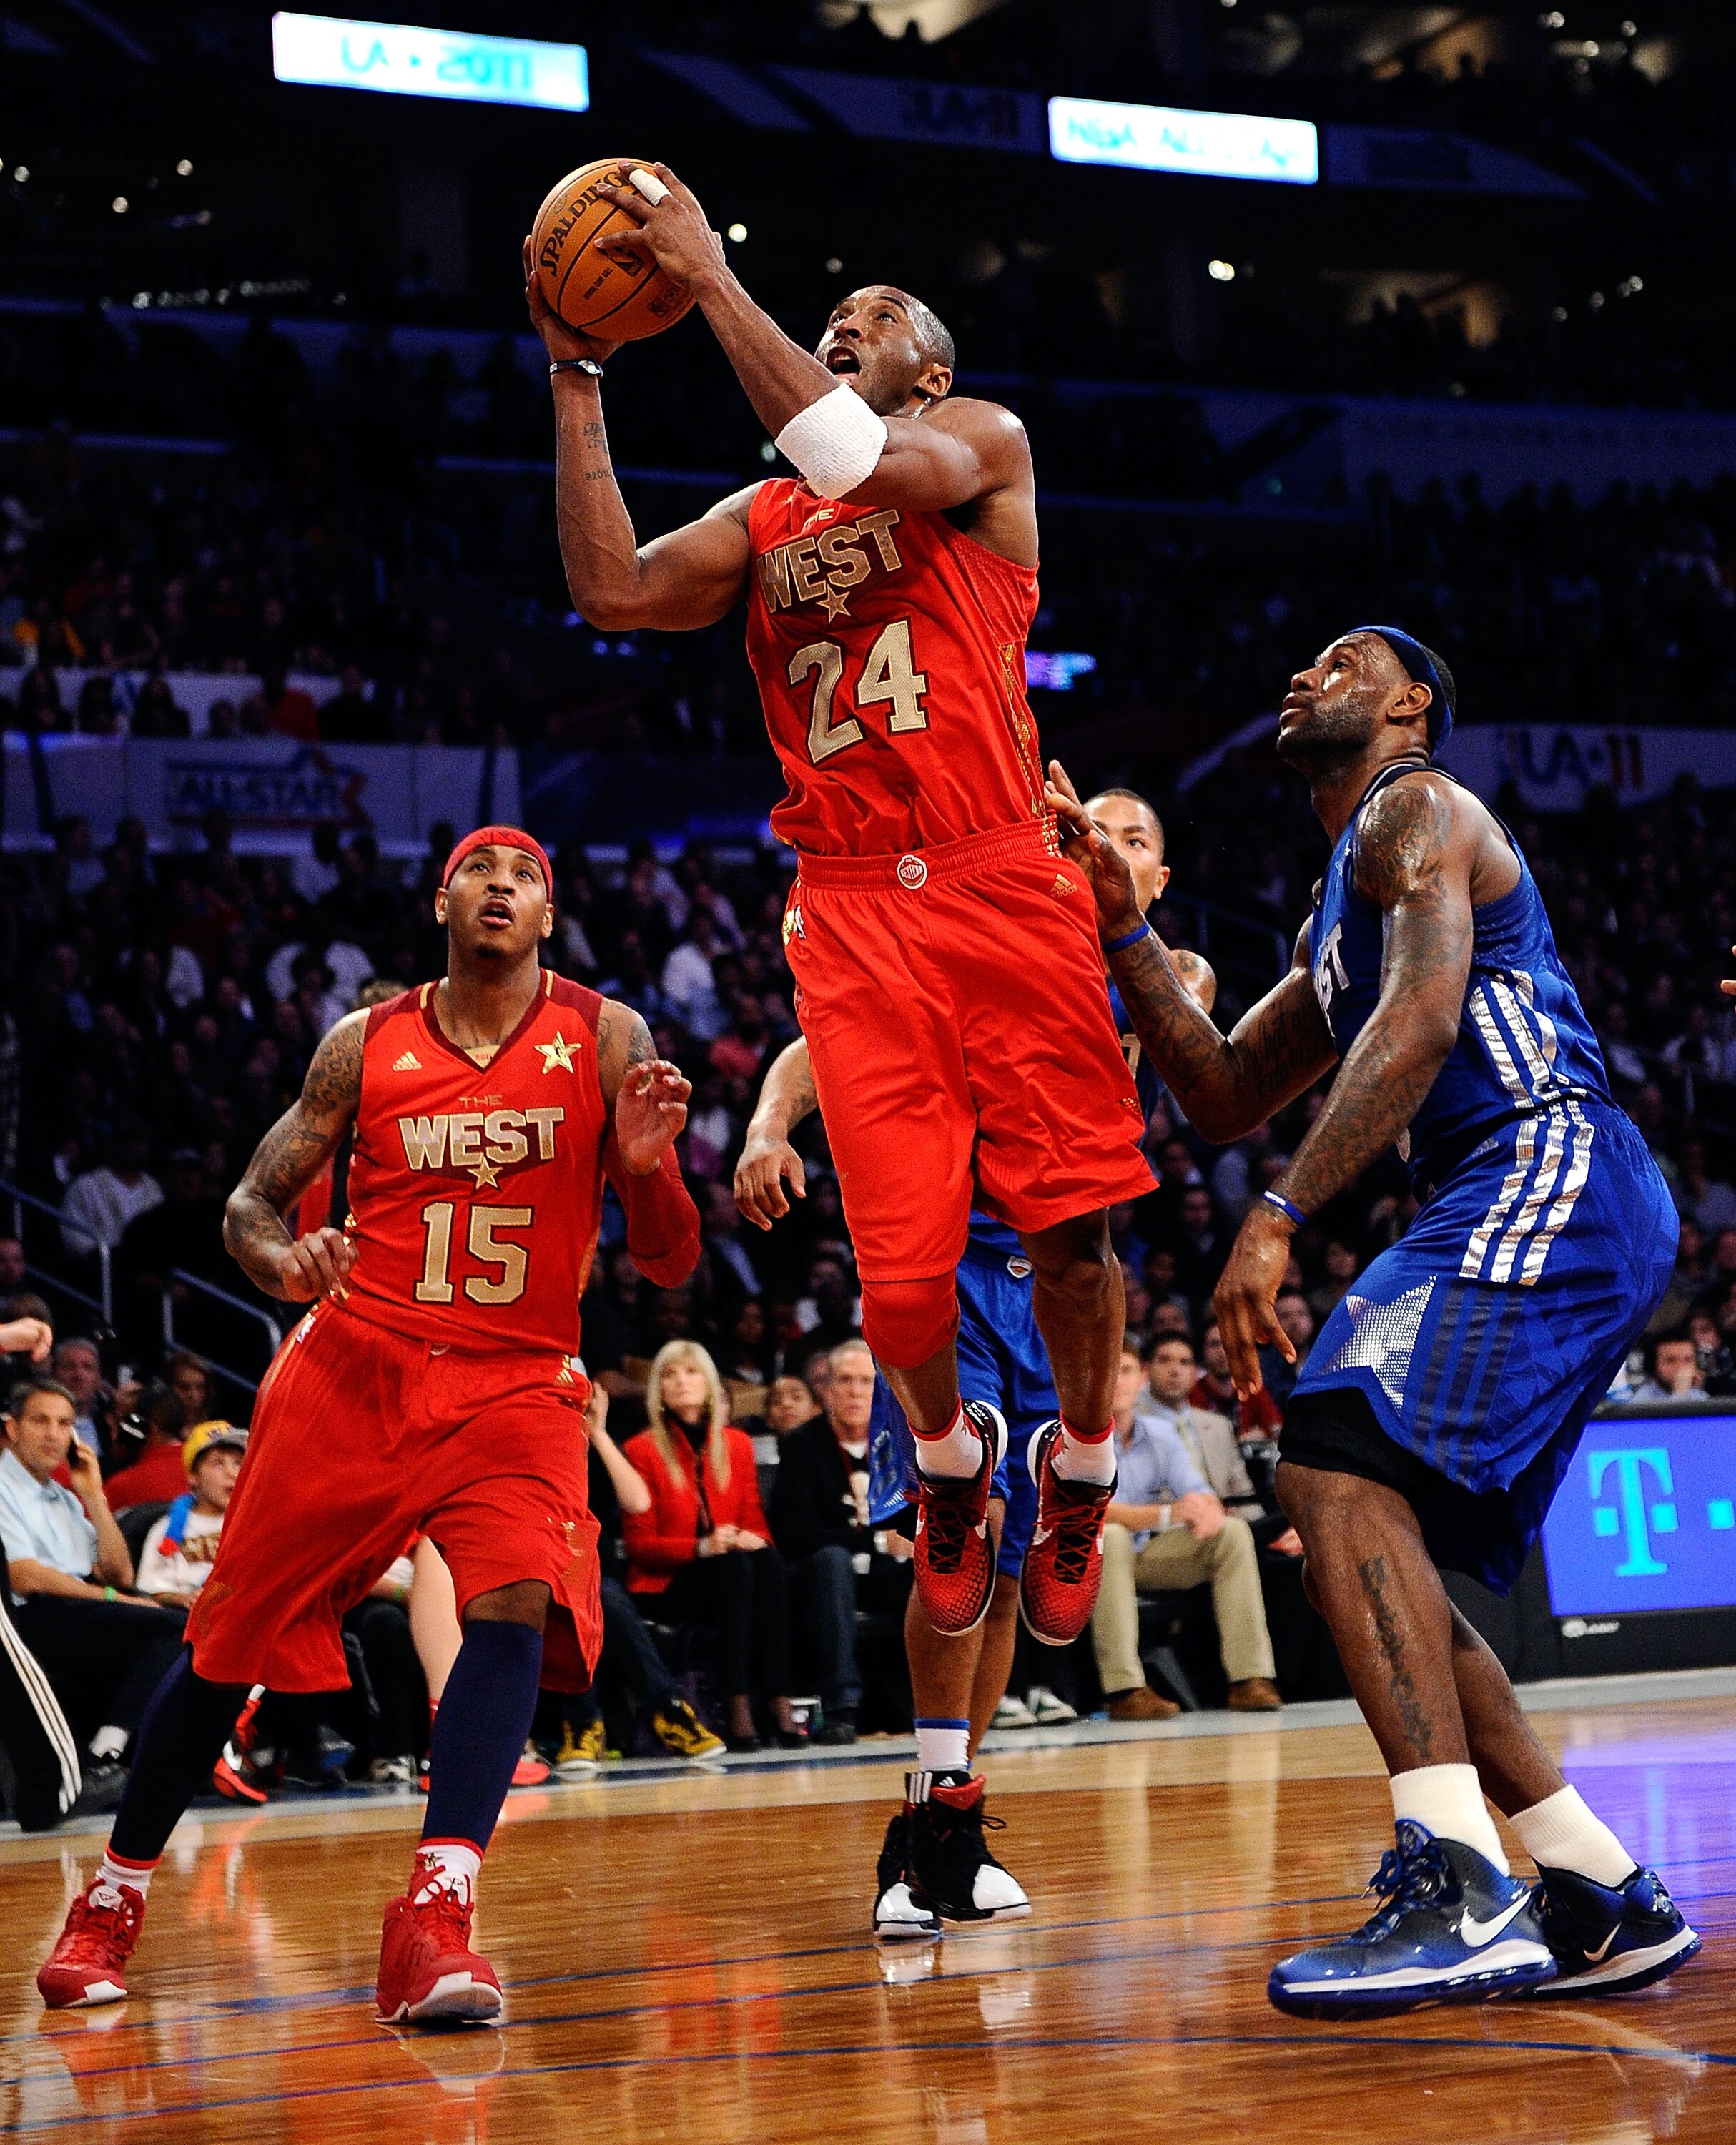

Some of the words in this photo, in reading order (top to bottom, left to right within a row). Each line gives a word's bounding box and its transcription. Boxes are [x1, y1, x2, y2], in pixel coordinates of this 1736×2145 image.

[756, 509, 902, 613] WEST
[788, 620, 927, 764] 24
[398, 1106, 564, 1170] WEST
[458, 1094, 503, 1108] THE
[415, 1201, 532, 1304] 15
